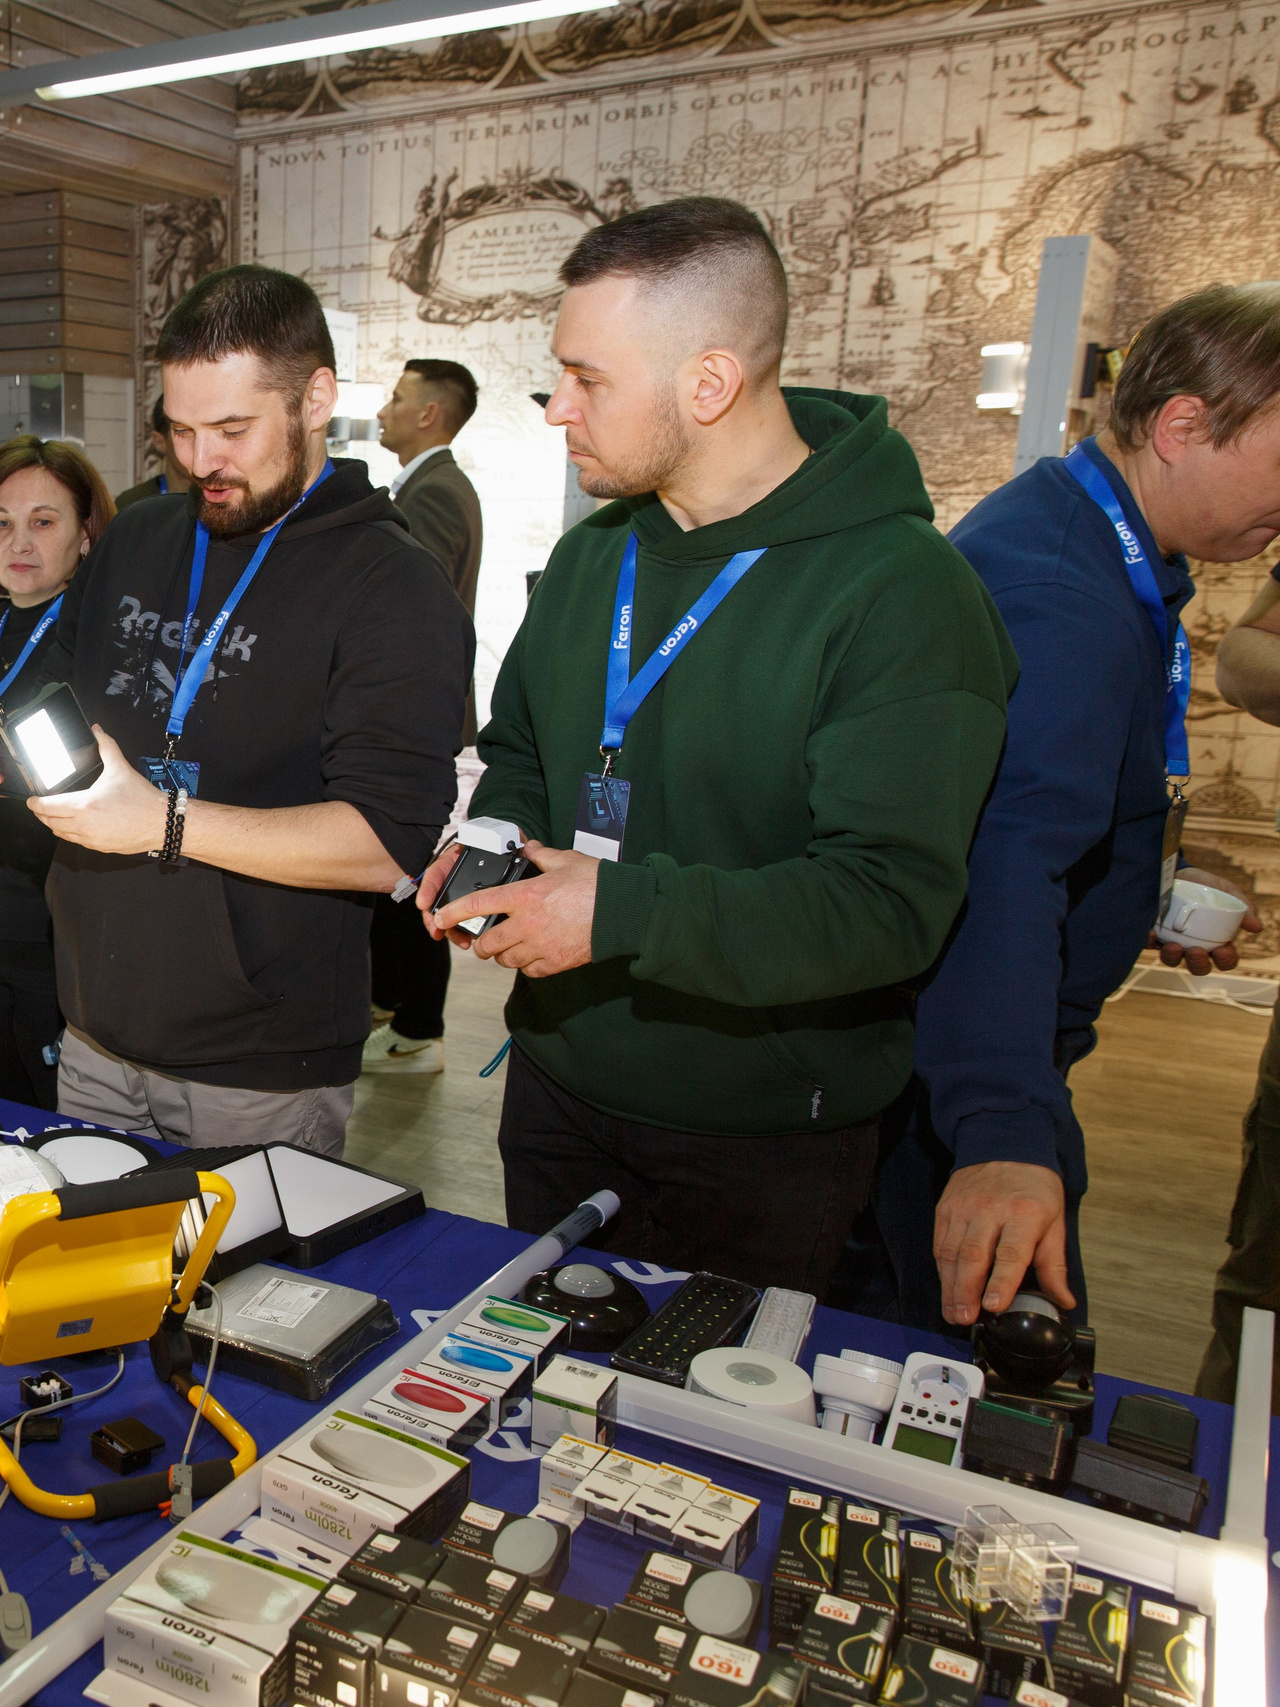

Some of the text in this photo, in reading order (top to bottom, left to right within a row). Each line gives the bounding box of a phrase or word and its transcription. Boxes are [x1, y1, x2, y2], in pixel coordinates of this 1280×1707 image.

[269, 151, 327, 168] NOVA
[341, 134, 432, 158] TOTIUS
[450, 114, 590, 143] TERRARUM
[605, 99, 678, 123] ORBIS
[470, 222, 560, 239] AMERICA
[1116, 521, 1143, 564] Feron
[31, 617, 53, 643] Feron
[203, 611, 229, 646] Feron
[614, 605, 630, 650] Feron
[659, 615, 698, 656] Feron
[325, 1421, 346, 1431] IC
[556, 1459, 576, 1468] Feron
[272, 1480, 288, 1491] GX70
[311, 1474, 359, 1500] Feron
[603, 1474, 625, 1485] Feron
[653, 1489, 676, 1500] Feron
[792, 1499, 816, 1507] 160
[271, 1506, 295, 1523] Feron
[465, 1515, 494, 1528] OSRAM
[701, 1510, 725, 1521] Feron
[850, 1514, 875, 1523] 160
[304, 1509, 352, 1540] 1280lm
[170, 1544, 191, 1558] IC
[913, 1540, 937, 1550] 160
[371, 1571, 411, 1592] Feron
[649, 1568, 682, 1582] OSRAM
[793, 1580, 827, 1593] Feron
[453, 1598, 495, 1620] Feron
[650, 1606, 686, 1623] Feron
[820, 1606, 850, 1620] 160
[931, 1613, 967, 1628] Feron
[161, 1617, 216, 1647] Feron
[327, 1630, 369, 1654] Feron
[532, 1634, 576, 1657] Feron
[1005, 1635, 1042, 1650] Feron
[117, 1656, 144, 1674] Feron
[413, 1660, 457, 1682] Feron
[625, 1658, 672, 1682] Feron
[698, 1656, 744, 1679] 160
[935, 1661, 968, 1678] 160
[155, 1659, 210, 1693] 1280lm
[819, 1666, 864, 1690] Feron
